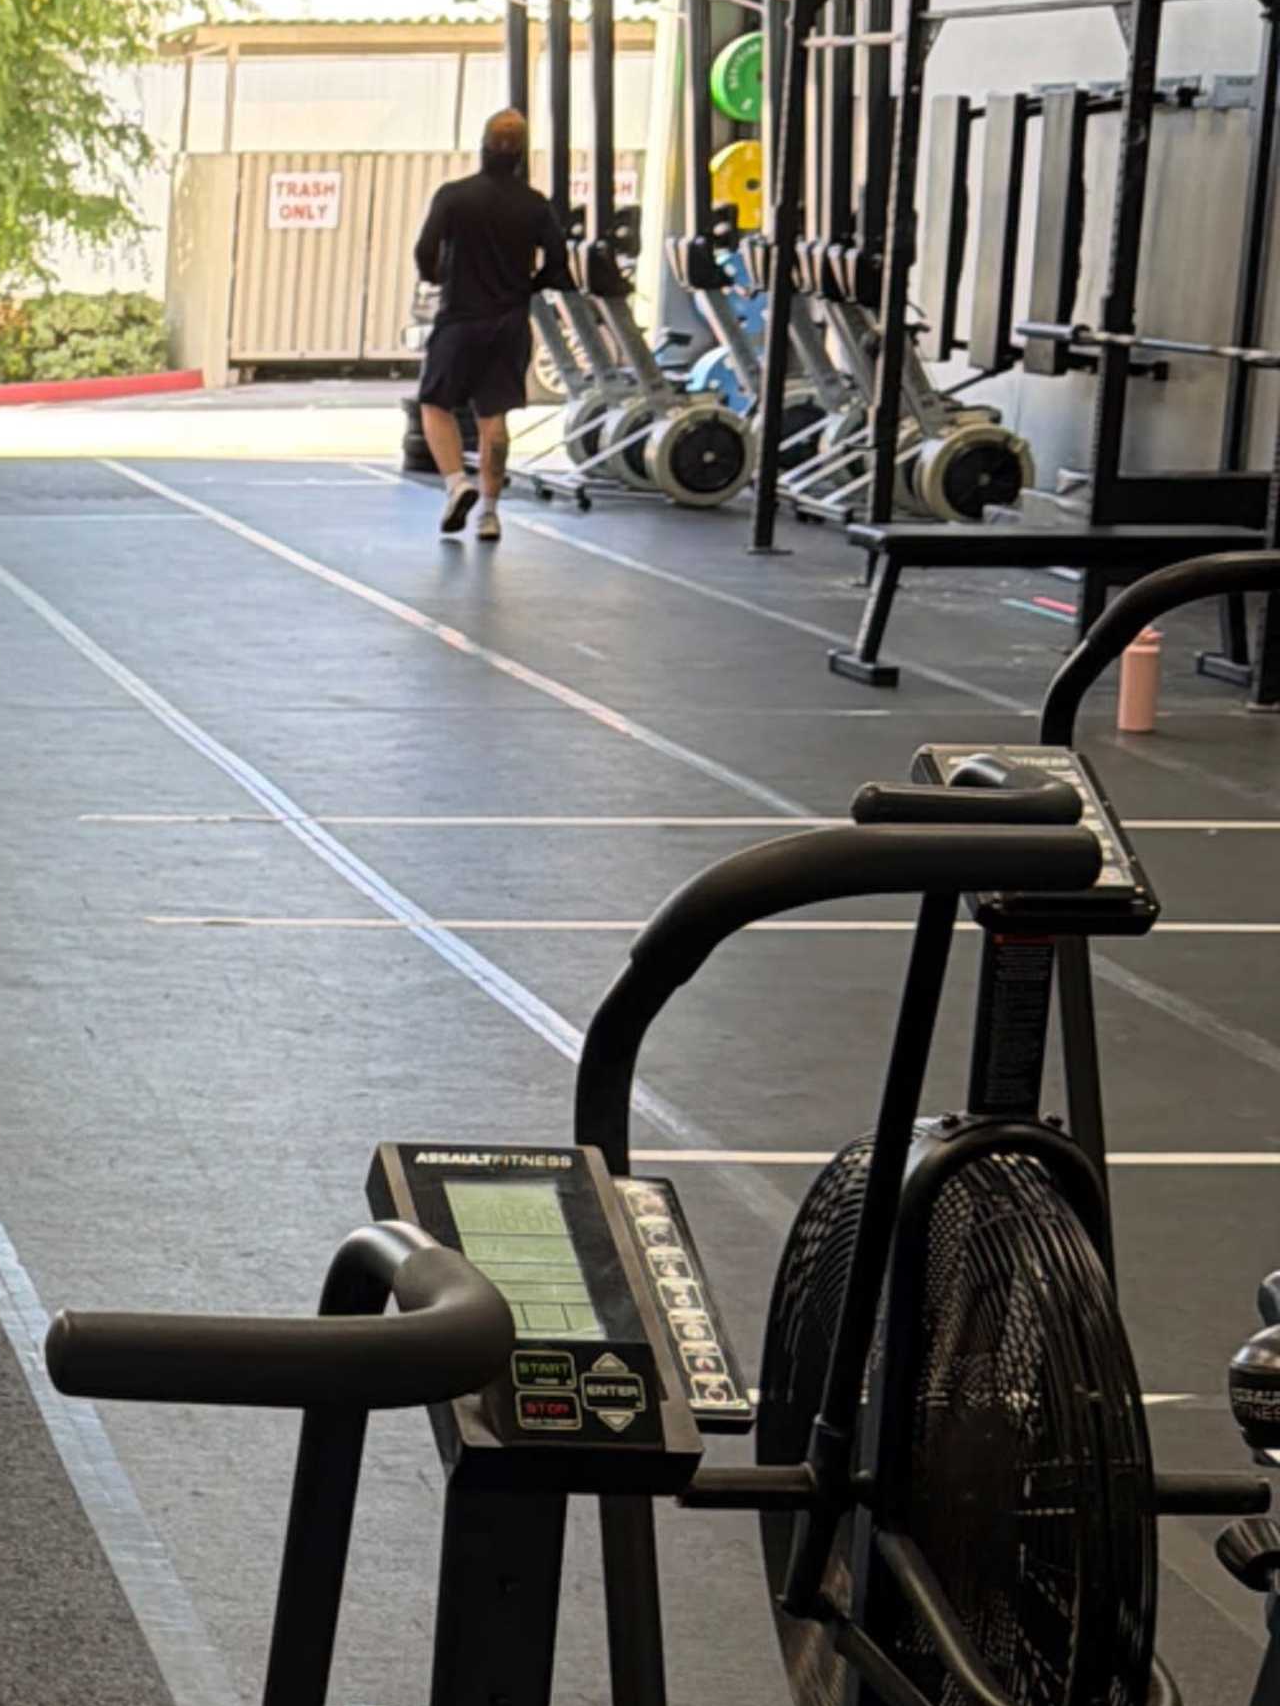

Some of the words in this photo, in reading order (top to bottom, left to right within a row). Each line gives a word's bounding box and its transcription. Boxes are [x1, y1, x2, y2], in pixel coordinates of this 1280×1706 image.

[276, 181, 336, 198] TRASH
[279, 204, 328, 221] ONLY
[414, 1151, 573, 1169] ASSAULTFITNESS
[519, 1362, 570, 1375] START
[586, 1384, 639, 1398] ENTER
[526, 1402, 570, 1415] STOP
